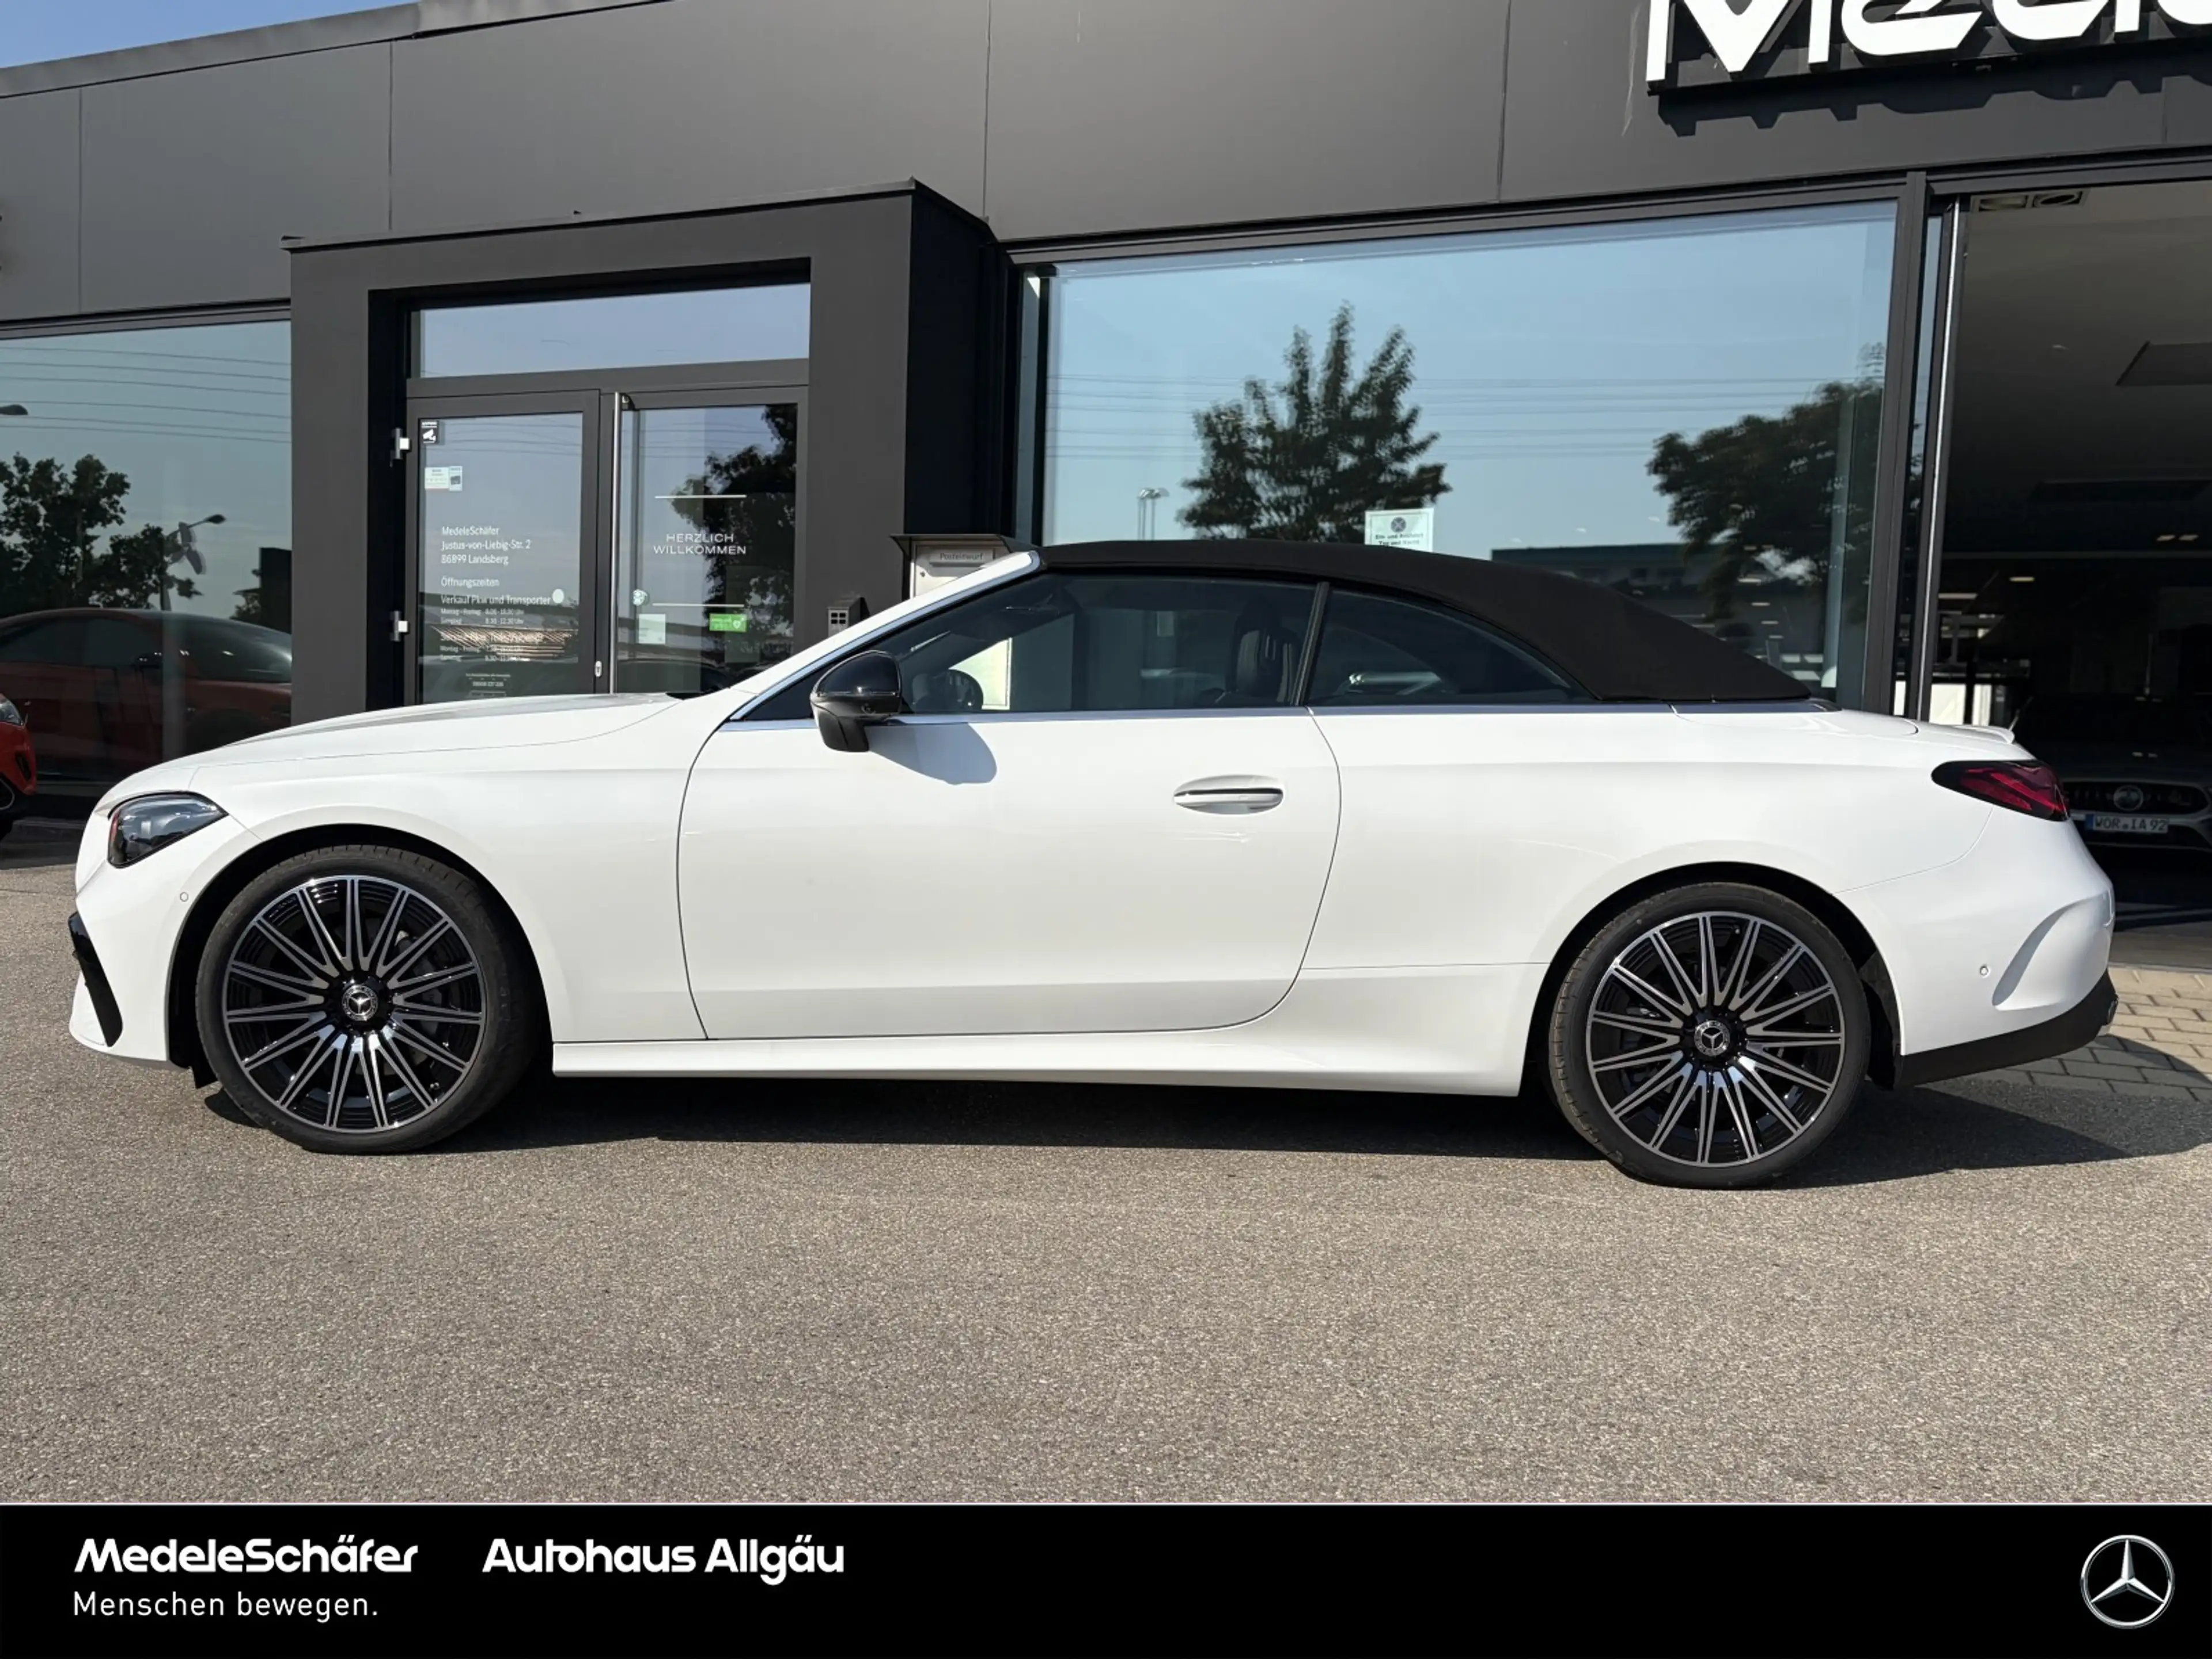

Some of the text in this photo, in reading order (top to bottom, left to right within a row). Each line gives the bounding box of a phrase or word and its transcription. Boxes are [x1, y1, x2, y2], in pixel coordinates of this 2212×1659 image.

[666, 533, 734, 543] HERZLICH
[525, 539, 531, 549] 2
[653, 546, 747, 555] WILLKOMMEN
[441, 554, 509, 566] 86899 Landsberg
[441, 576, 499, 588] Öffnungszeiten
[441, 594, 469, 604] Verkauf
[488, 595, 504, 604] und
[506, 595, 551, 605] Transporter
[2131, 818, 2147, 829] IA
[2150, 819, 2167, 831] 92
